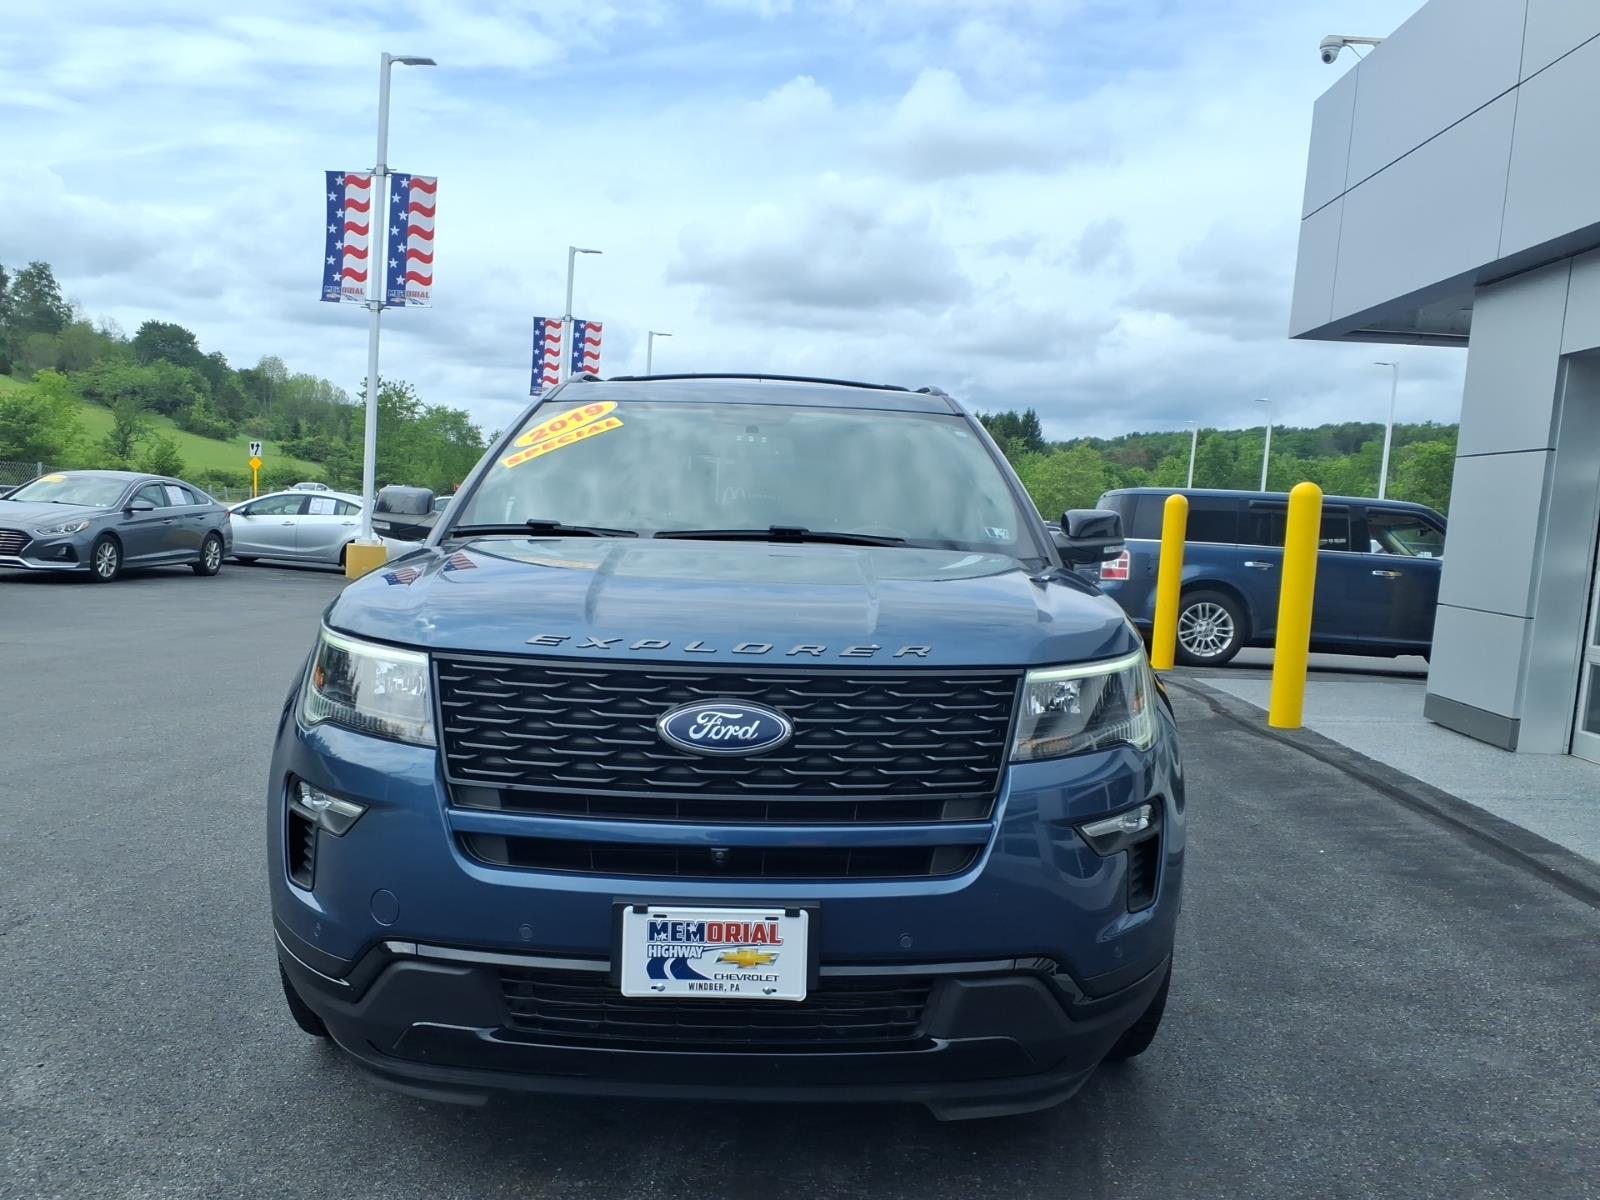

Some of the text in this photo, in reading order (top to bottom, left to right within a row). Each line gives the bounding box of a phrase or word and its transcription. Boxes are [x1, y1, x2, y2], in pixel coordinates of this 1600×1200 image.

[529, 404, 605, 443] 2019
[525, 634, 933, 658] EXPLORER
[689, 711, 760, 741] Ford
[647, 920, 783, 945] MEMORIAL
[647, 945, 704, 959] HIGHWAY
[688, 982, 740, 992] WINDBER, PA
[713, 973, 779, 982] CHEVROLET
